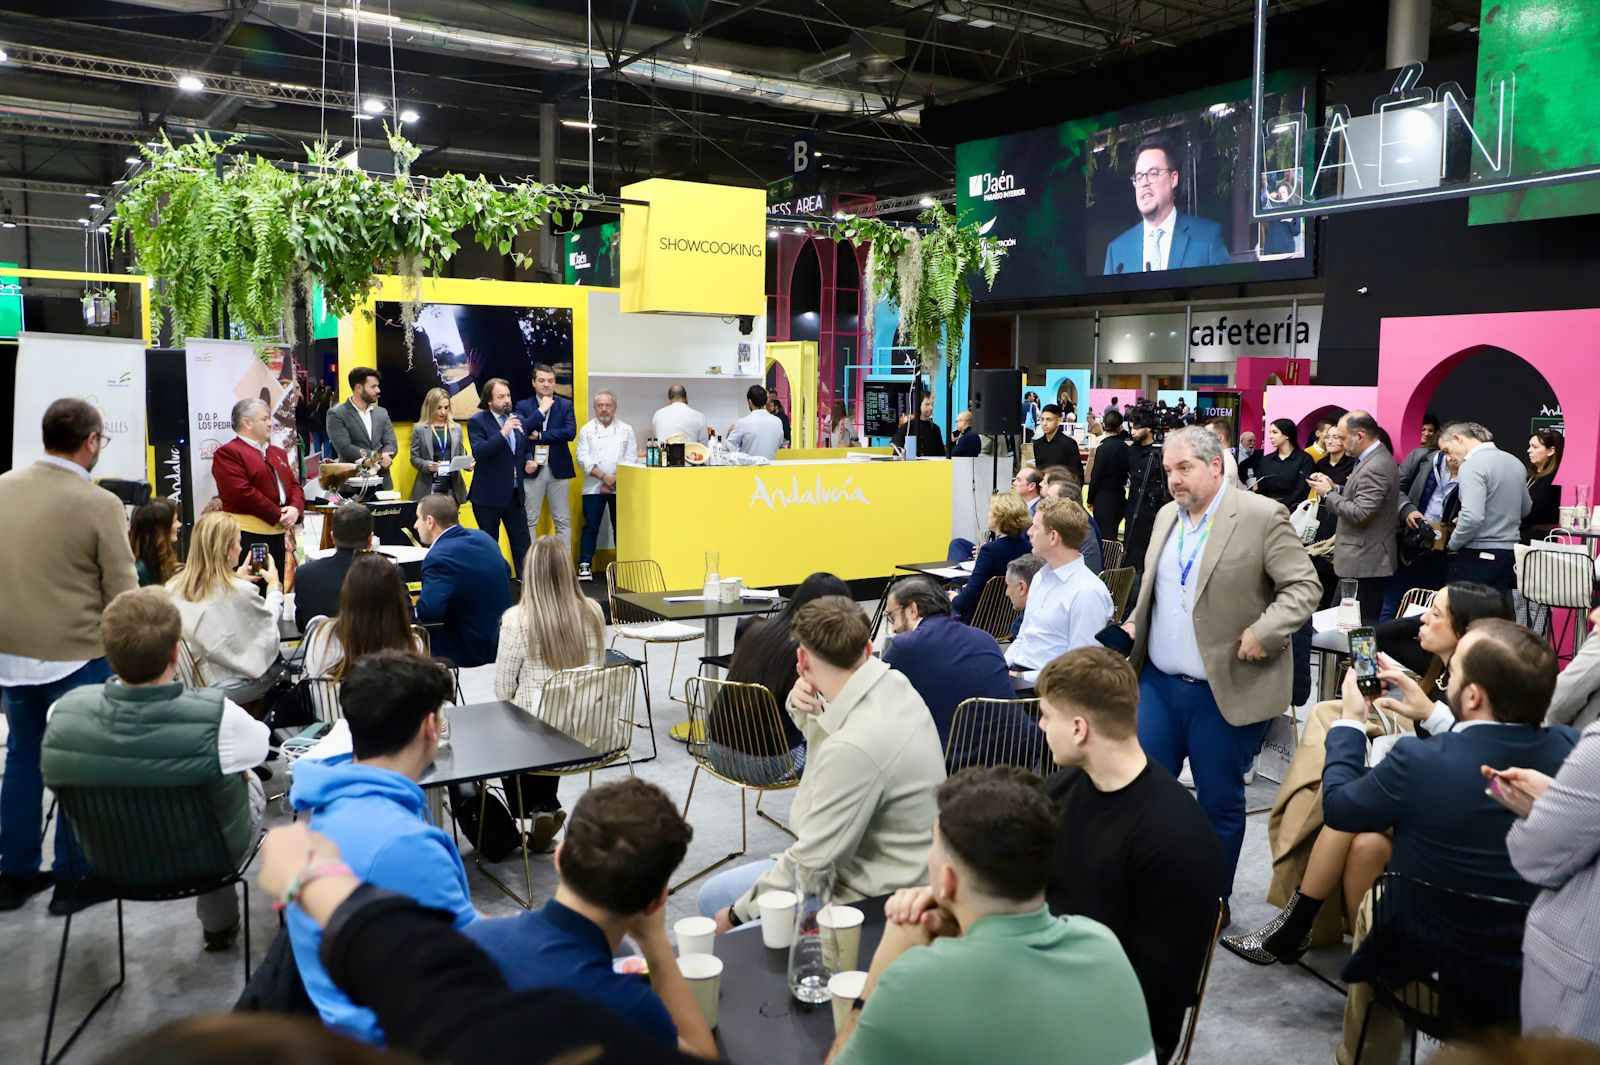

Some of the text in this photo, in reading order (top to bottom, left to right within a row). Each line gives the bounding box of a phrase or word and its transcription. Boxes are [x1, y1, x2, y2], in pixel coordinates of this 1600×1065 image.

[1265, 69, 1505, 203] JAÉN
[793, 140, 809, 172] B
[983, 170, 1014, 195] Jaén
[1003, 188, 1026, 199] INTERIOR
[795, 194, 823, 214] AREA
[659, 237, 762, 257] SHOWCOOKING
[1190, 314, 1310, 347] cafetería
[1205, 407, 1233, 417] TOTEM
[198, 421, 232, 430] LOS PEDR
[163, 446, 182, 504] Andaluc
[748, 471, 873, 510] Andalucía
